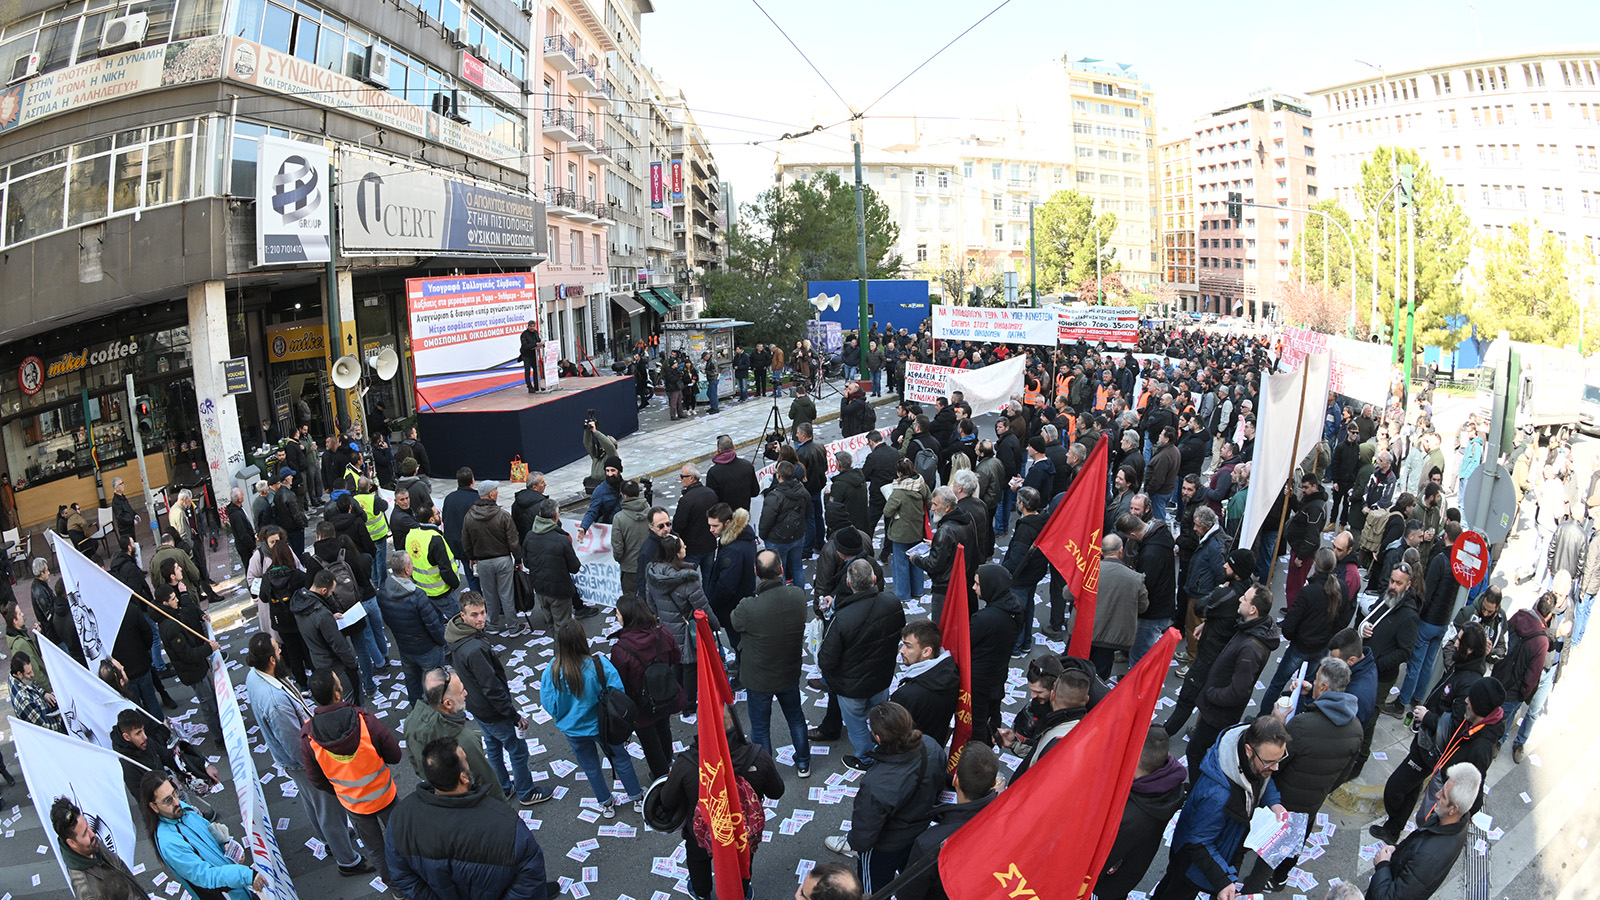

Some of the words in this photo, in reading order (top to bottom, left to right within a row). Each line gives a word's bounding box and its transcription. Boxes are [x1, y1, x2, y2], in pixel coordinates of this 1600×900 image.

[29, 76, 54, 92] ΣΤΗΝ
[57, 63, 101, 83] ΕΝΟΤΗΤΑ
[105, 60, 113, 69] Η
[117, 48, 163, 66] ΔΥΝΑΜΗ
[26, 90, 52, 106] ΣΤΟΝ
[55, 80, 86, 96] ΑΓΩΝΑ
[90, 78, 98, 86] Η
[101, 70, 125, 84] ΝΙΚΗ
[265, 52, 352, 98] ΣΥΝΔΙΚΑΤΟ
[357, 85, 423, 125] ΟΙΚΟΔΟΜΩΝ
[25, 102, 58, 120] ΑΣΠΙΔΑ
[62, 98, 69, 108] Η
[73, 80, 138, 105] ΑΛΛΗΛΕΓΓΥΗ
[263, 76, 275, 87] ΚΑΙ
[277, 81, 321, 101] ΕΡΓΑΖΟΜΕΝΩΝ
[324, 95, 335, 105] ΣΤΑ
[360, 107, 373, 118] ΥΛΙΚΑ
[375, 112, 383, 120] ΚΑΙ
[384, 115, 395, 125] ΣΤΙΣ
[396, 120, 423, 134] ΚΑΤΑΣΚΕΥΕΣ
[443, 128, 461, 139] ΣΤΟΝ
[444, 120, 461, 131] ΣΤΗΝ
[463, 127, 490, 143] ΕΝΟΤΗΤΑ
[443, 137, 467, 150] ΑΣΠΙΔΑ
[467, 192, 472, 206] Ο
[474, 194, 505, 212] ΑΠΟΛΥΤΟΣ
[506, 201, 533, 217] ΚΥΡΙΑΡΧΟΣ
[299, 219, 322, 228] GROUP
[467, 211, 488, 226] ΣΤΗΝ
[491, 214, 533, 232] ΠΙΣΤΟΠΟΙΗΣΗ
[468, 229, 500, 245] ΦΥΣΙΚΩΝ
[502, 233, 534, 246] ΠΡΟΣΩΠΩΝ
[428, 281, 460, 293] Υπογραφή
[462, 280, 495, 290] Συλλογικής
[496, 279, 521, 288] Σύμβασης
[414, 298, 437, 310] Αυξήσεις
[448, 295, 475, 307] μεροκάματα
[417, 312, 449, 323] Αναγνώριση
[938, 308, 947, 316] ΝΑ
[1001, 311, 1009, 319] ΤΑ
[429, 324, 446, 334] Μέτρα
[447, 321, 474, 333] ασφάλειας
[942, 328, 970, 336] ΣΥΝΔΙΚΑΤΟ
[424, 333, 468, 348] ΟΜΟΣΠΟΝΔΙΑ
[470, 328, 504, 340] ΟΙΚΟΔΟΜΩΝ
[505, 324, 529, 334] ΕΛΛΑΔΑ
[48, 348, 88, 378] mikel
[90, 341, 138, 365] coffee
[908, 363, 922, 371] ΥΠΕΡ
[925, 366, 955, 374] ΑΓΝΩΣΤΩΝ
[907, 372, 935, 380] ΑΣΦΑΛΕΙΑ
[914, 378, 945, 388] ΟΙΚΟΔΟΜΟΙ
[917, 386, 945, 395] ΣΥΓΧΡΟΝΗ
